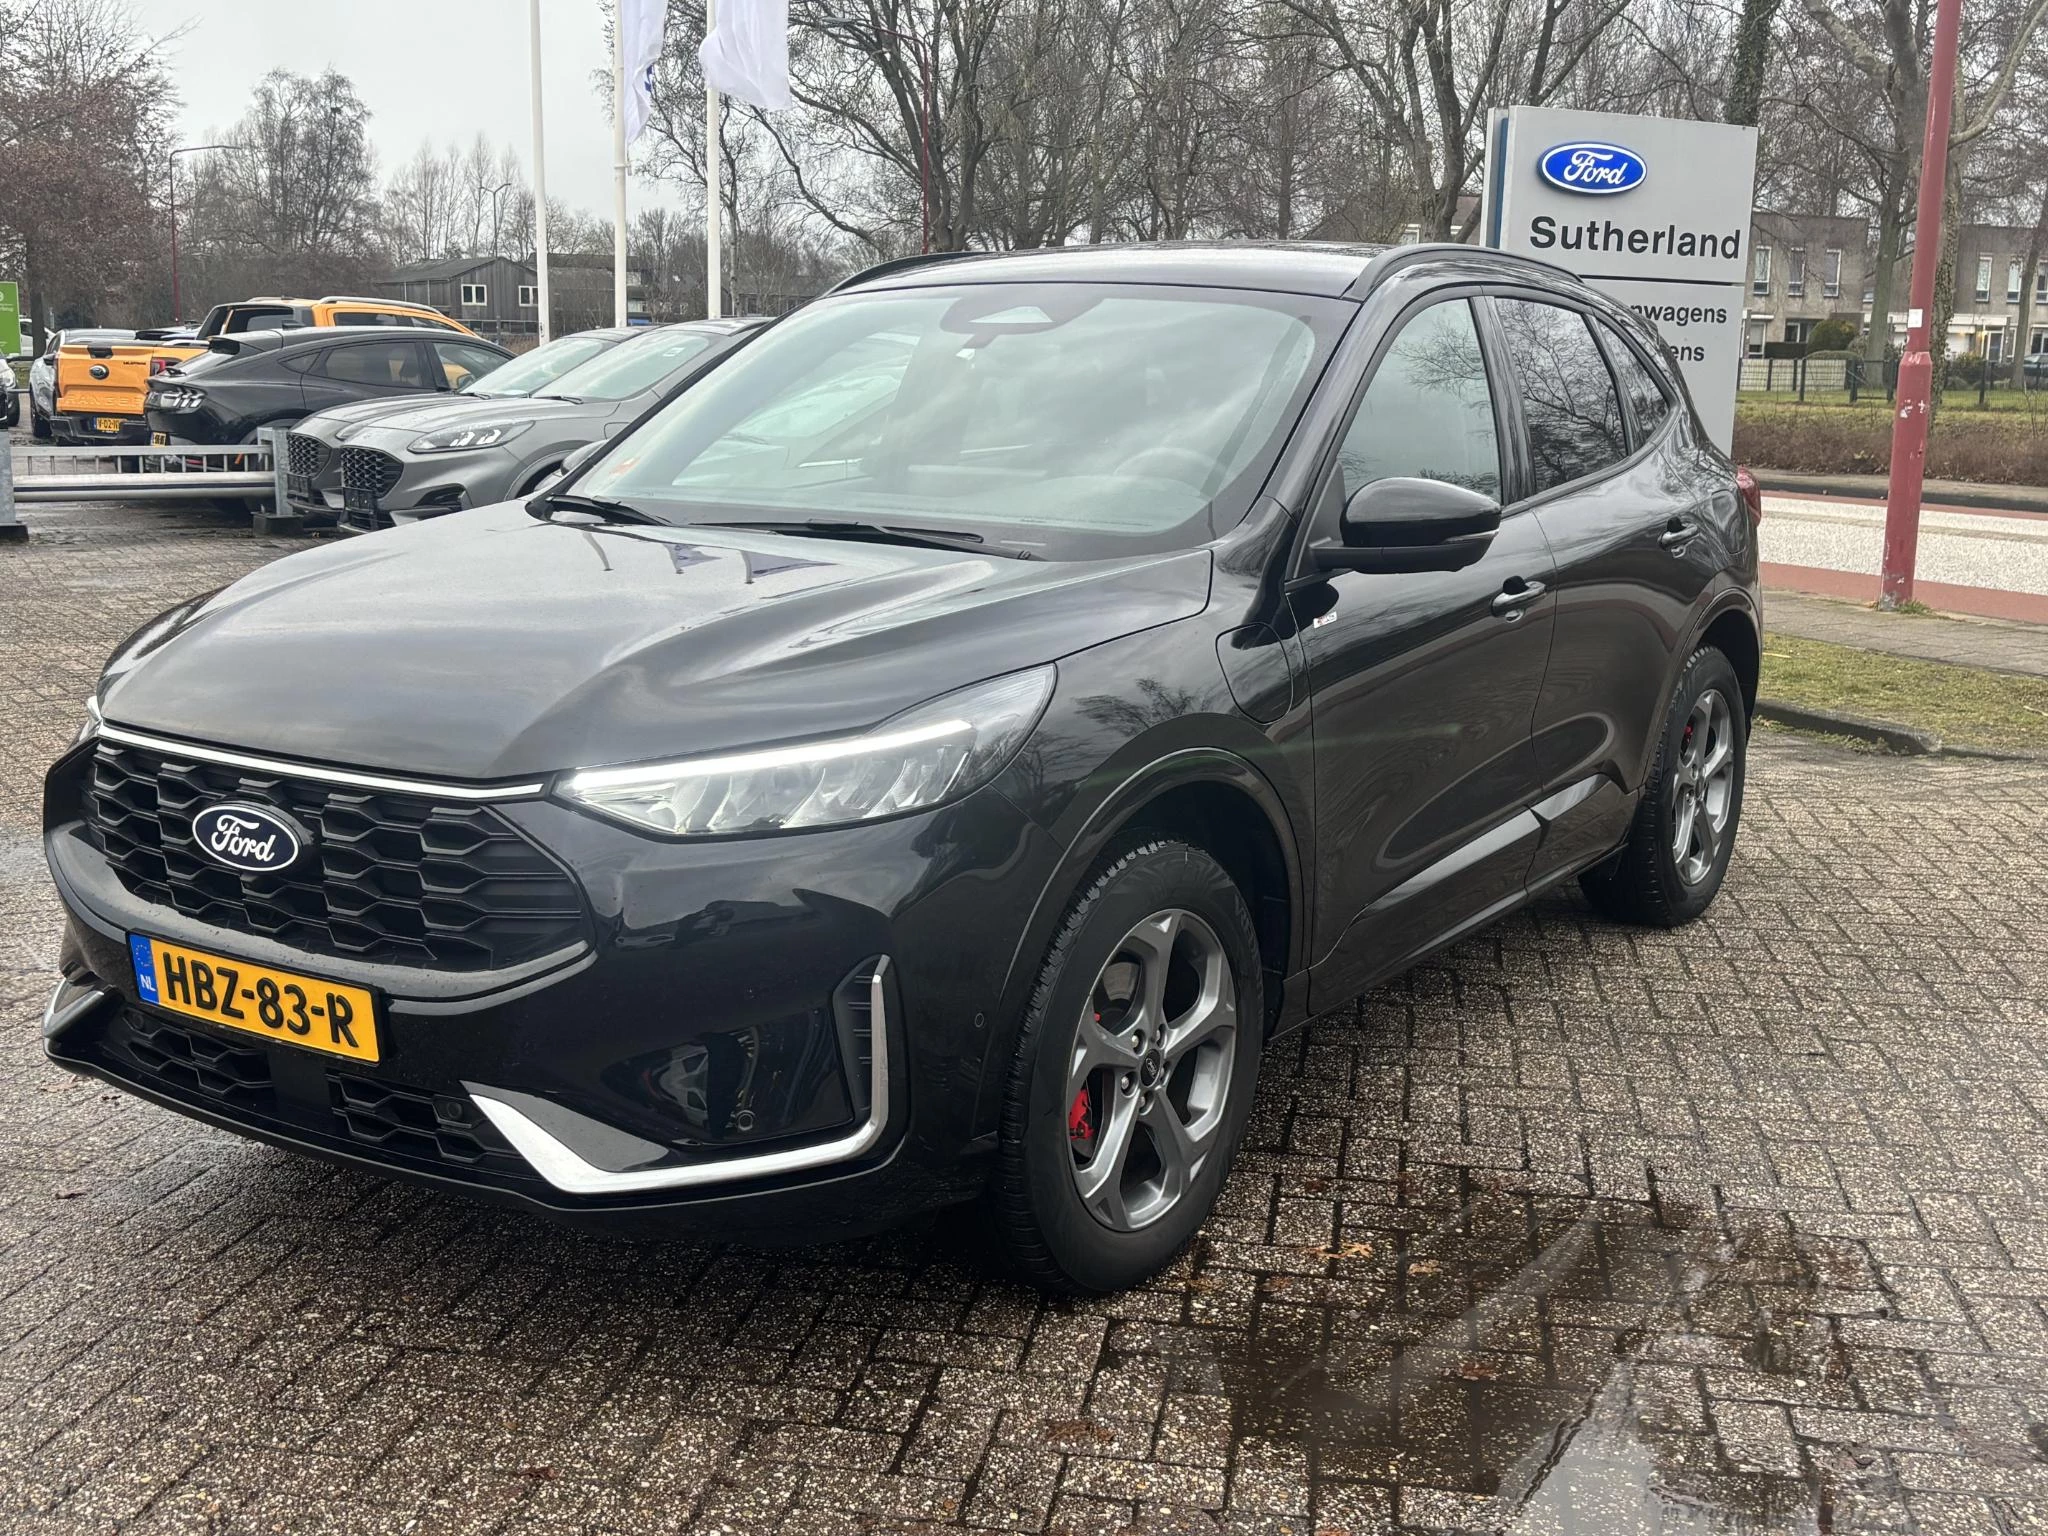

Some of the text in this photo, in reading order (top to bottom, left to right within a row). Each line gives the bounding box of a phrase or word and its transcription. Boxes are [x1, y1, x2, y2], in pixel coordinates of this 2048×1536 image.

[1563, 150, 1628, 185] Ford
[1530, 216, 1740, 259] Sutherland
[211, 814, 276, 862] Ford
[140, 951, 359, 1047] NL HBZ-83-R
